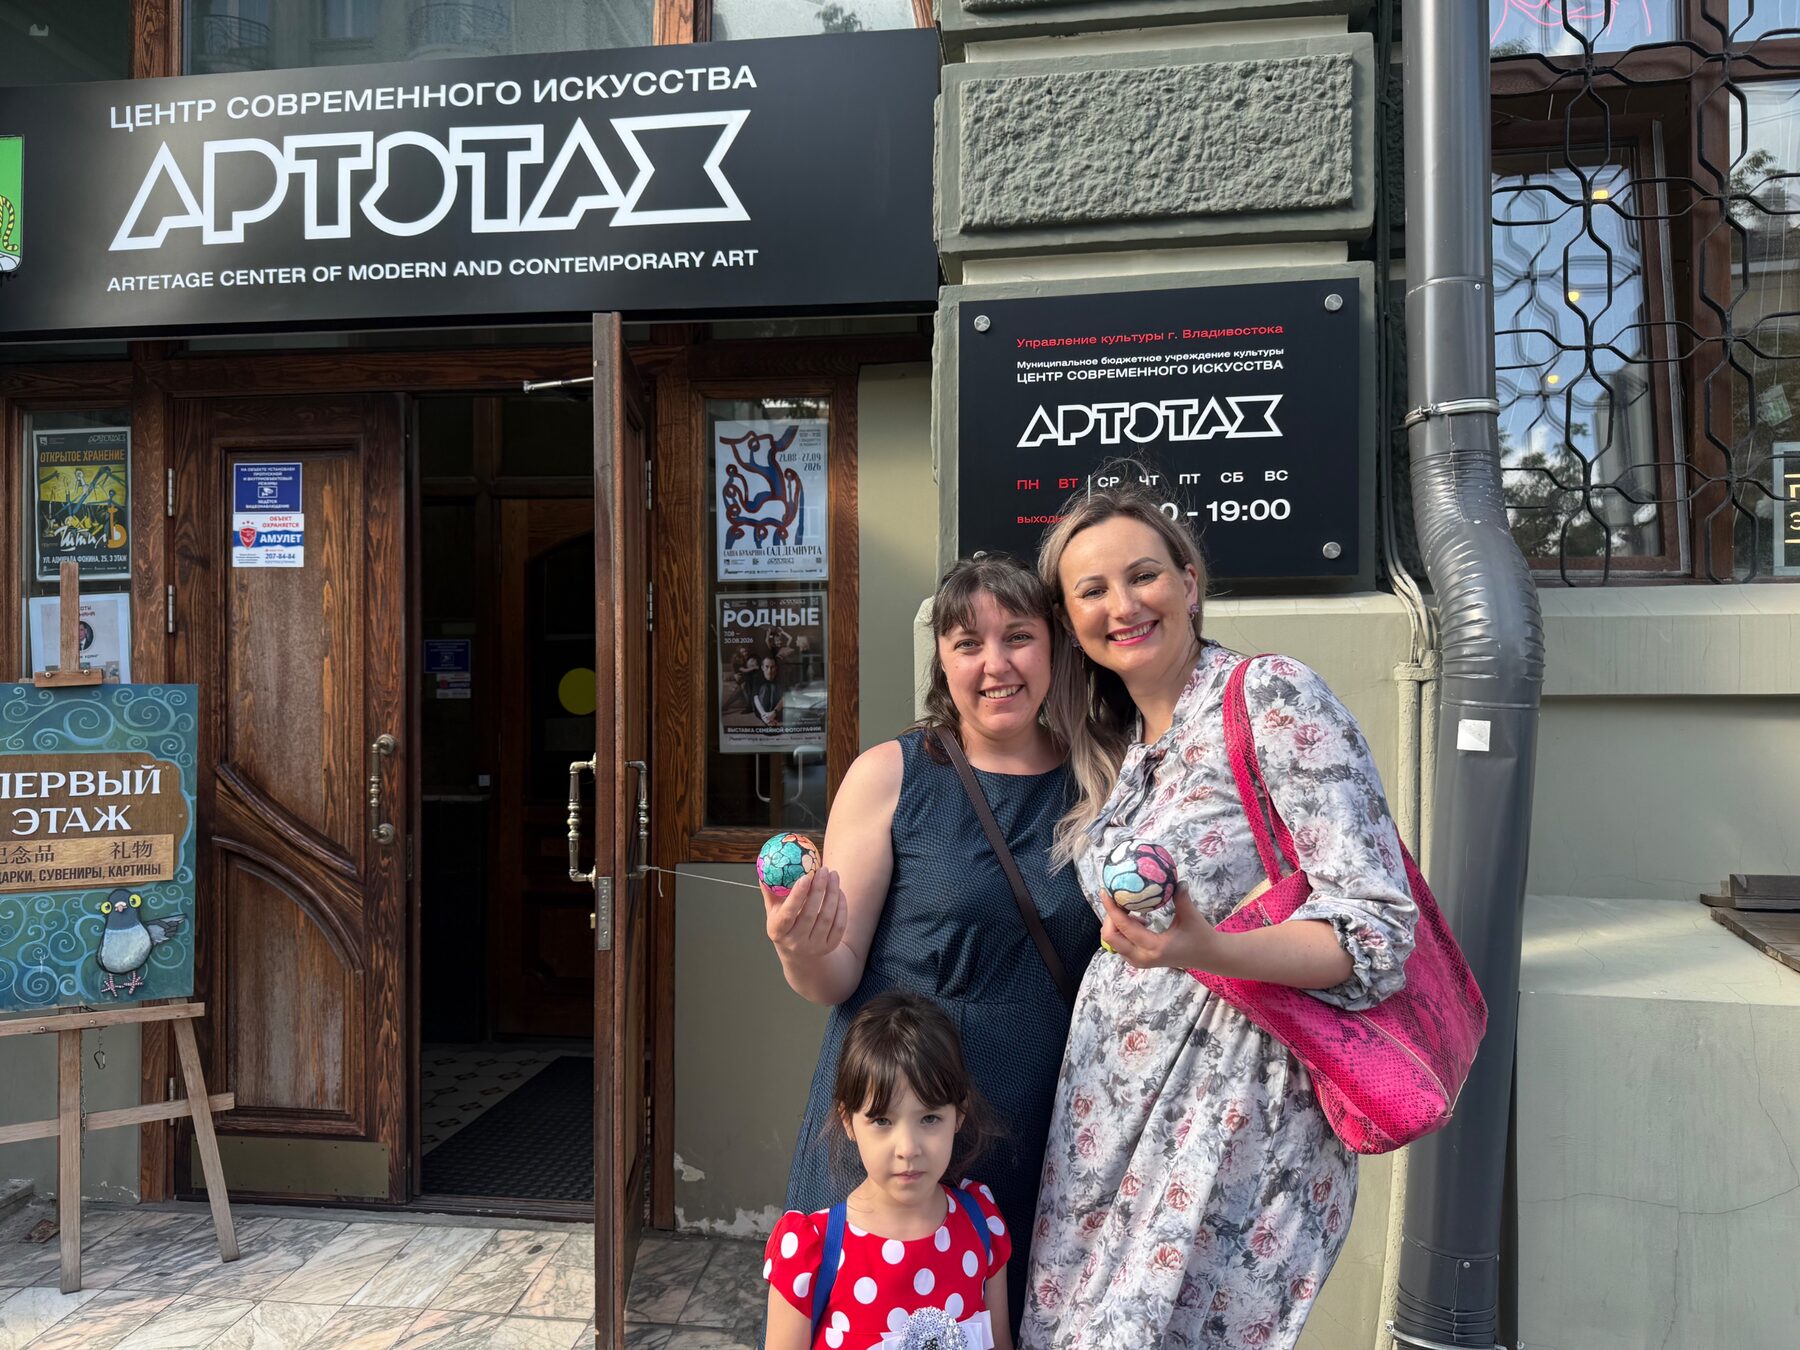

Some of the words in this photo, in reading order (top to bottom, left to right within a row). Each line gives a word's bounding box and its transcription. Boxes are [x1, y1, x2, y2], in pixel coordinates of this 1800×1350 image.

[110, 99, 216, 132] ЦЕНТР
[226, 80, 522, 119] СОВРЕМЕННОГО
[533, 65, 758, 103] ИСКУССТВА
[107, 271, 214, 292] ARTETAGE
[219, 267, 306, 287] CENTER
[312, 265, 342, 283] OF
[348, 261, 447, 281] MODERN
[453, 259, 502, 277] AND
[508, 251, 705, 276] CONTEMPORARY
[711, 249, 759, 267] ART
[1017, 336, 1097, 349] Управление
[1101, 333, 1164, 345] культуры
[1167, 332, 1178, 340] г.
[1182, 325, 1284, 339] Владивостока
[1017, 359, 1098, 370] Муниципальное
[1101, 355, 1162, 366] бюджетное
[1165, 350, 1231, 363] учреждение
[1233, 348, 1284, 359] культуры
[1017, 371, 1063, 385] ЦЕНТР
[1067, 365, 1188, 381] СОВРЕМЕННОГО
[1192, 360, 1284, 375] ИСКУССТВА
[40, 450, 82, 463] ОТКРЫТОЕ
[82, 448, 125, 462] ХРАНЕНИЕ
[1017, 479, 1040, 490] ПН
[1058, 478, 1079, 489] ВТ
[1097, 476, 1120, 488] СР
[1139, 475, 1160, 486] ЧТ
[1179, 473, 1201, 485] ПТ
[1220, 472, 1244, 484] СБ
[1264, 470, 1289, 482] ВС
[1206, 498, 1291, 522] 19:00
[259, 534, 302, 543] АМУЛЕТ
[723, 607, 820, 628] РОДНЫЕ
[11, 804, 132, 836] ЭТАЖ
[110, 839, 153, 860] 礼物
[39, 867, 105, 882] СУВЕНИРЫ,
[108, 863, 161, 878] КАРТИНЫ
